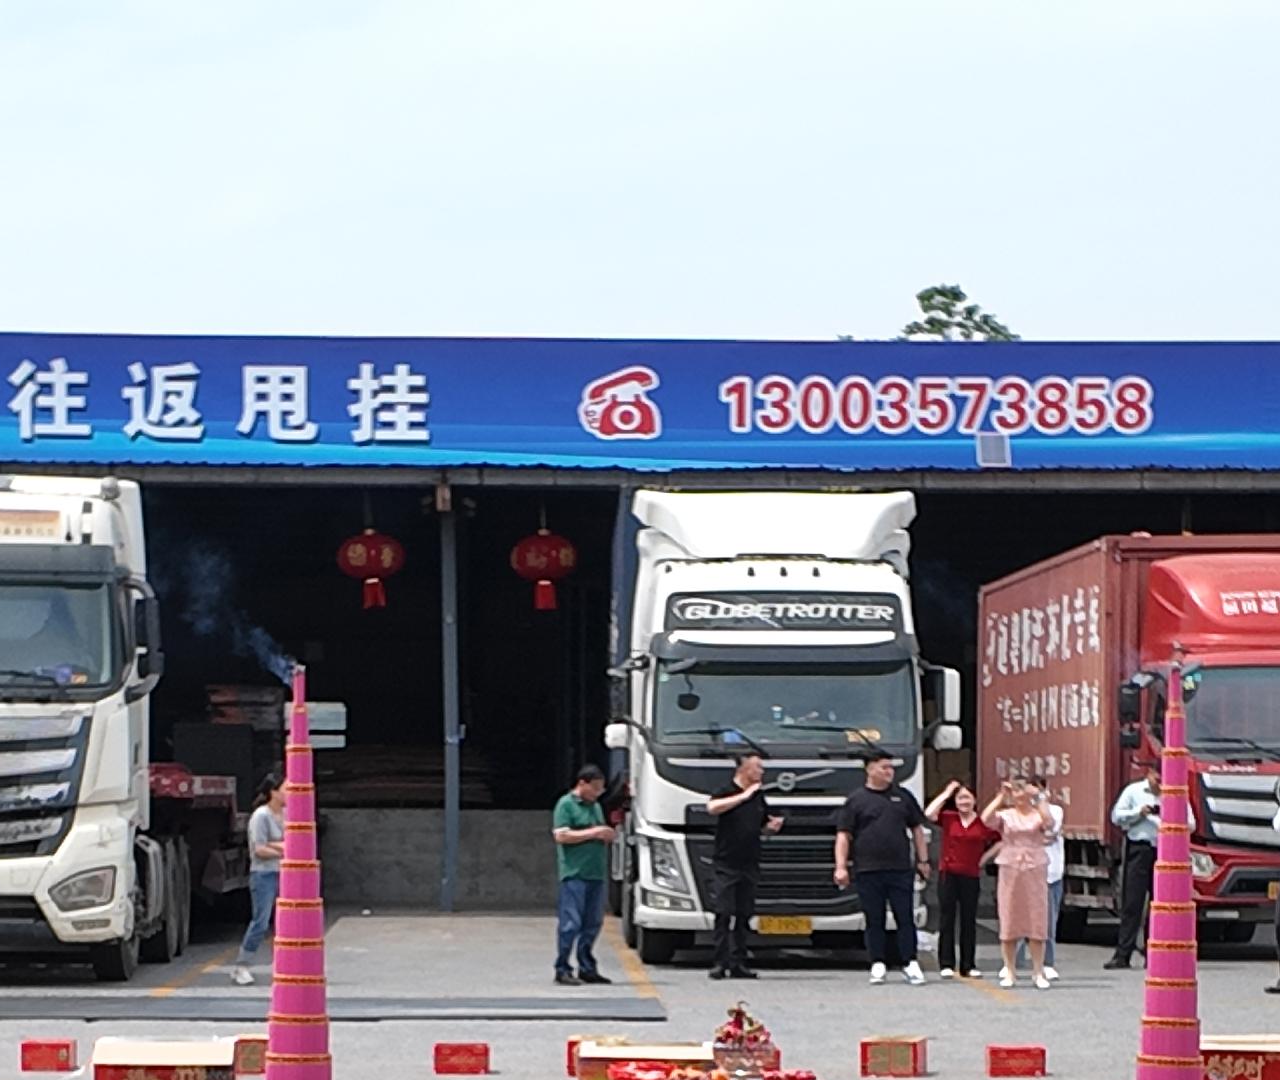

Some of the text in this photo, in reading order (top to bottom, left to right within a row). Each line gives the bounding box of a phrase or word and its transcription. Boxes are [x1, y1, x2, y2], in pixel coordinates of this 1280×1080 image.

[7, 357, 432, 446] 往返甩挂
[719, 375, 1155, 436] 13003573858
[683, 602, 895, 621] GLOBETROTTER
